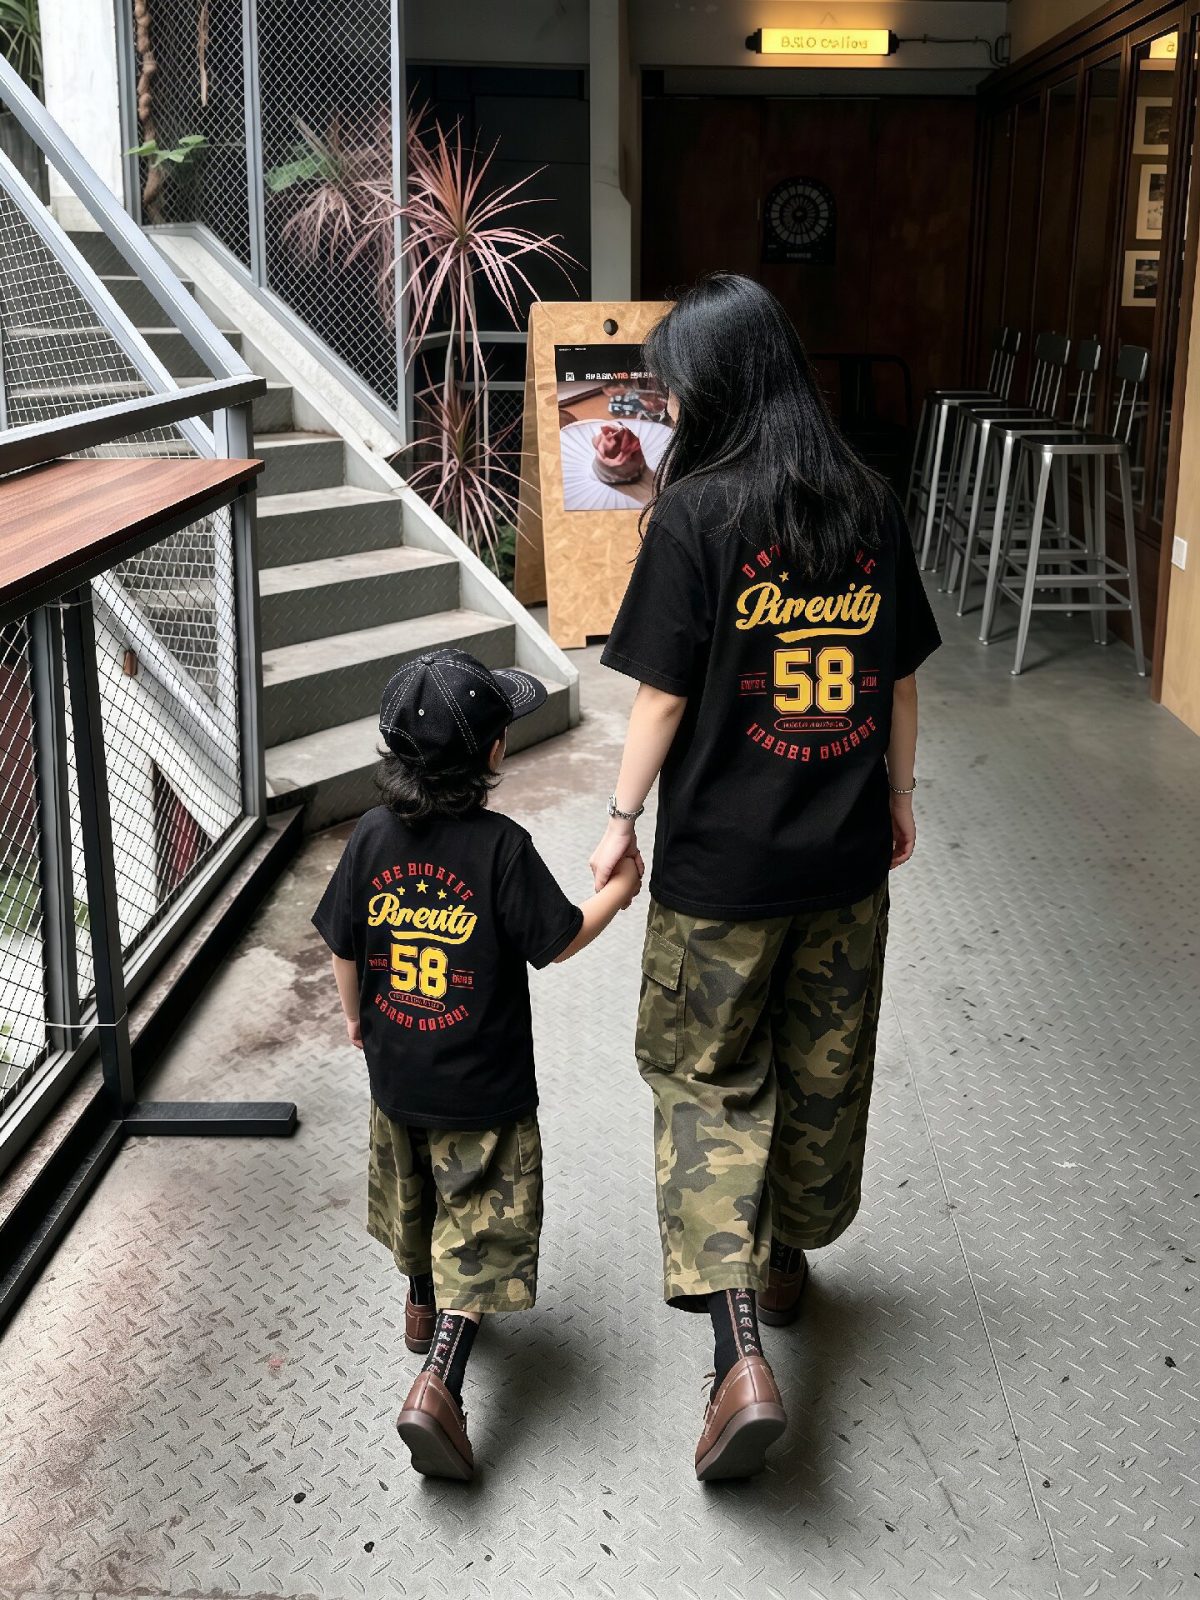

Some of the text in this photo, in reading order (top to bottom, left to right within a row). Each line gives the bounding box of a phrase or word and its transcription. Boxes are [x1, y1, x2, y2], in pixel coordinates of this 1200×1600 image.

[774, 646, 855, 715] 58
[367, 892, 478, 945] Brevity
[390, 942, 449, 1000] 58
